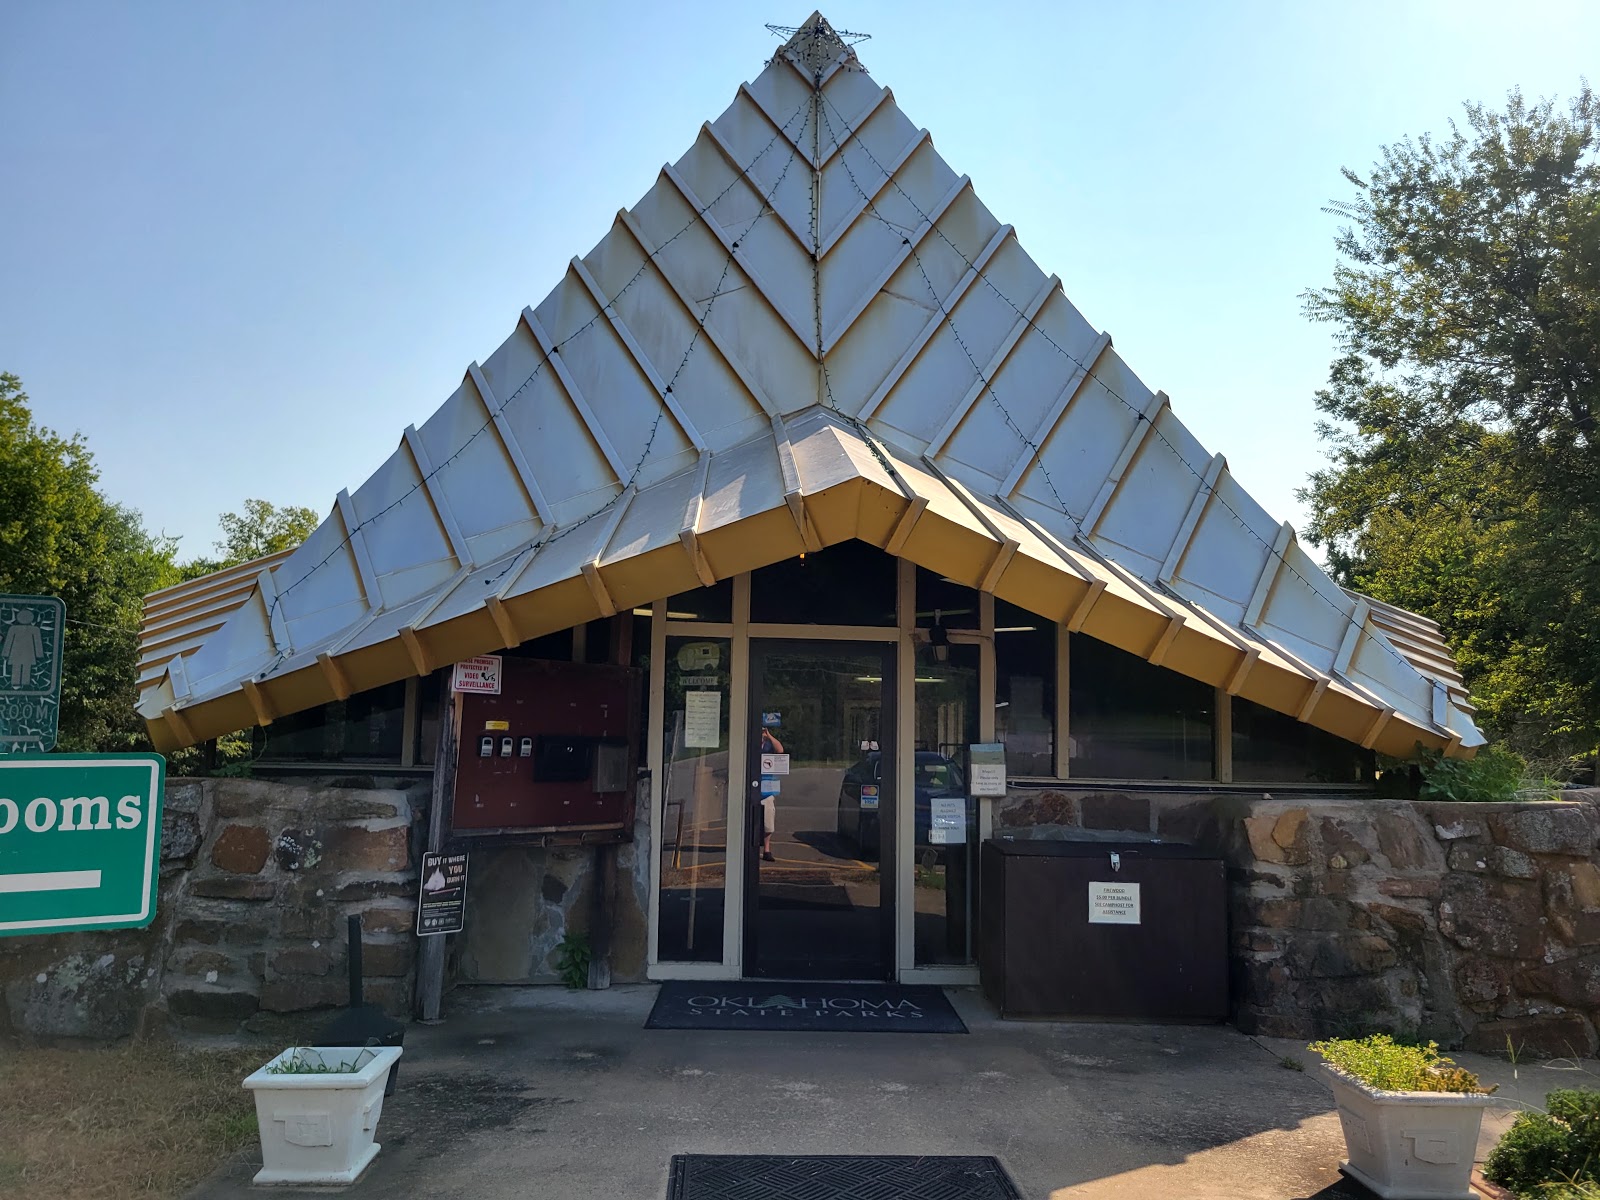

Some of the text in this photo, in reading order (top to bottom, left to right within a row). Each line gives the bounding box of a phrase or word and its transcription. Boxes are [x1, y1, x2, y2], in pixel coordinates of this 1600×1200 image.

[459, 680, 495, 688] SURVEILLANCE
[428, 857, 442, 867] BUY
[448, 855, 466, 863] WHERE
[449, 865, 463, 875] YOU
[447, 876, 460, 884] BURN
[689, 1008, 924, 1018] STATE PARKS
